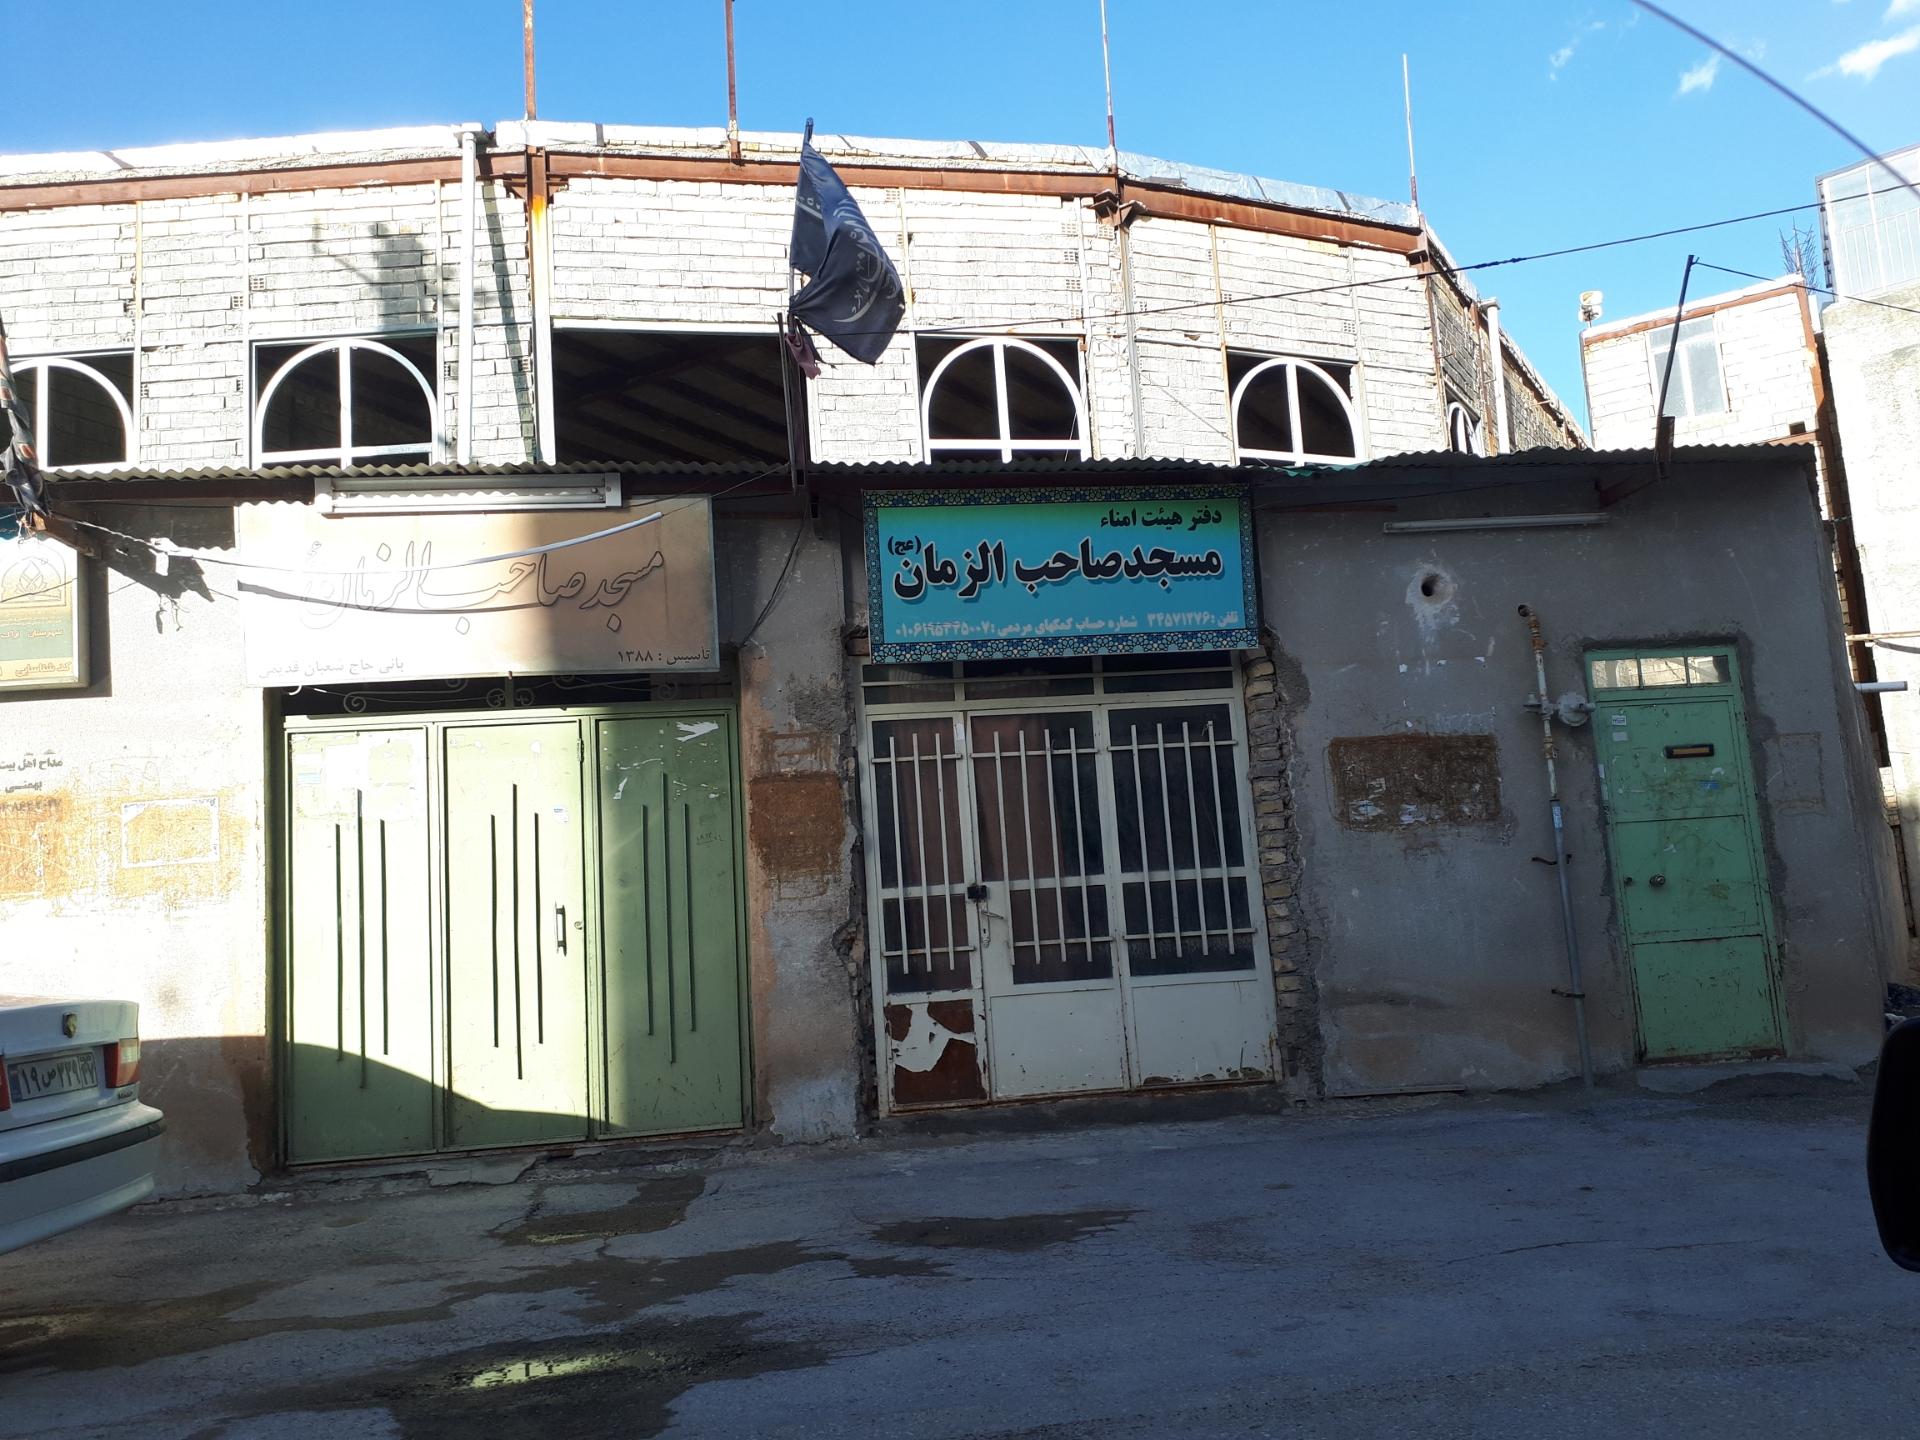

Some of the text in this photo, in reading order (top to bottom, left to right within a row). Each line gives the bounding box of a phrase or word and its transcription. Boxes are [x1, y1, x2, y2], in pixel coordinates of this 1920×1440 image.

[1188, 506, 1223, 530] دفتر
[893, 539, 1004, 600] الزمان
[617, 648, 654, 663] ۱۳۸۸
[304, 660, 345, 678] شعبان
[349, 659, 374, 676] حاج
